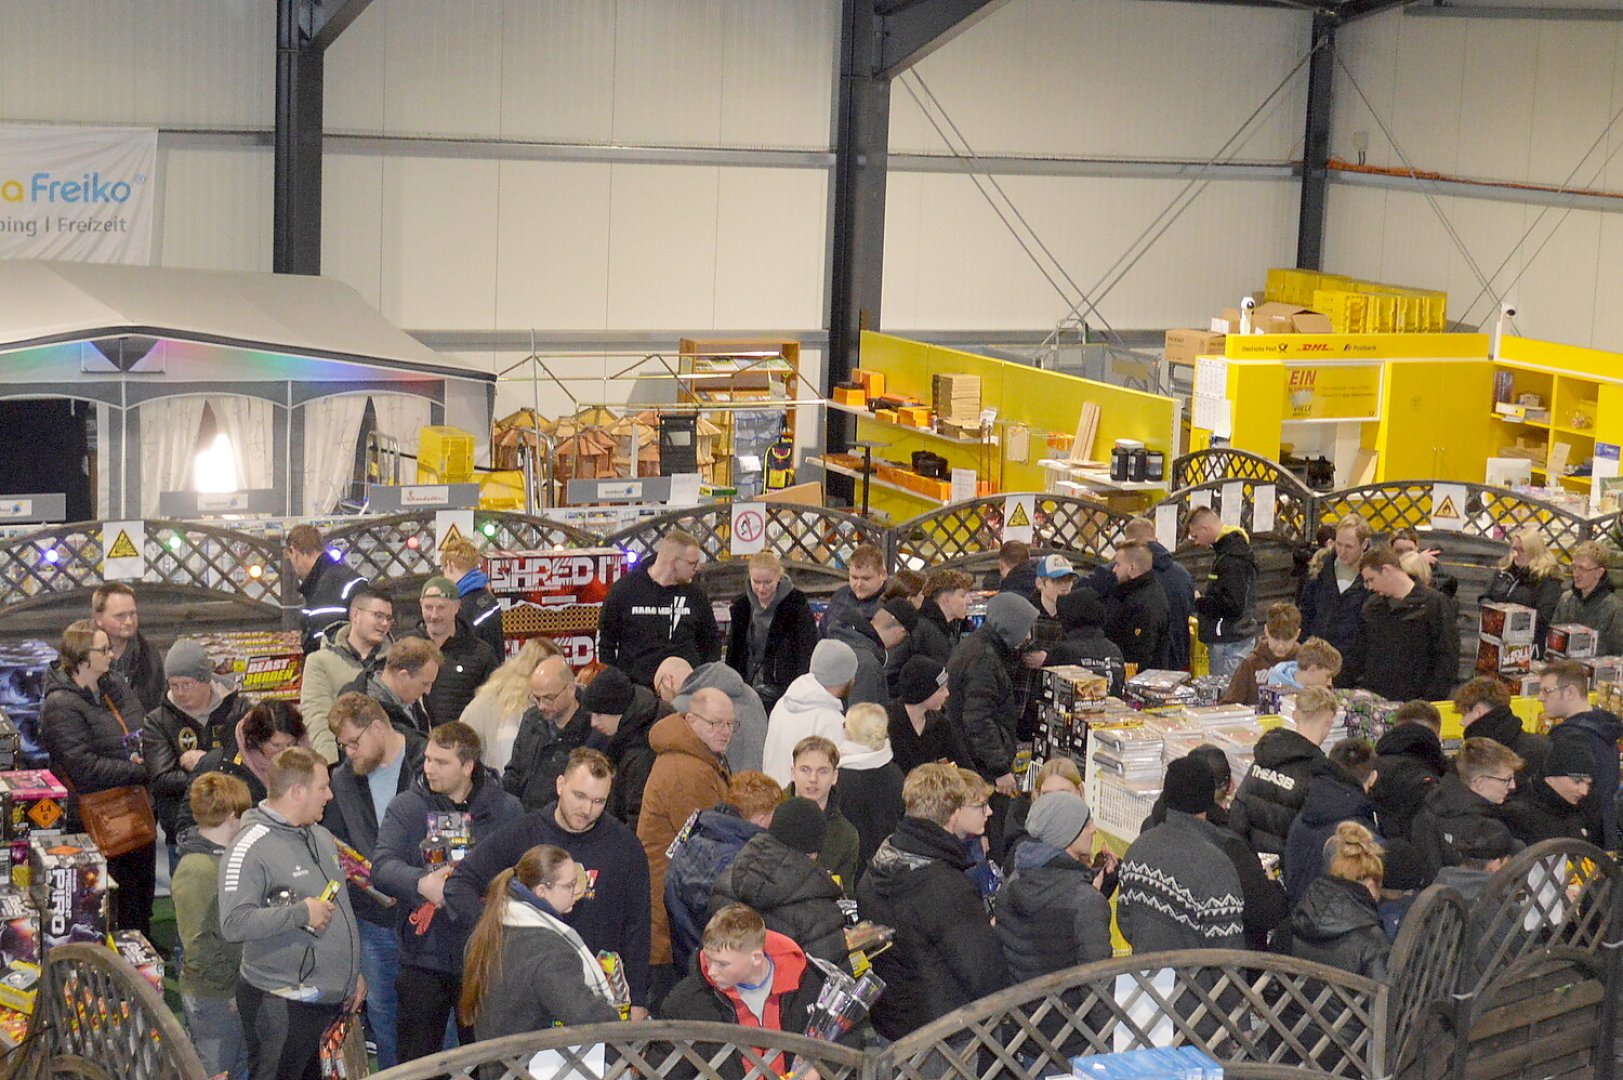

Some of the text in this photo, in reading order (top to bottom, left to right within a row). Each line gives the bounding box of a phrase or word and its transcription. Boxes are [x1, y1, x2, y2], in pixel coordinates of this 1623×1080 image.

[57, 215, 127, 233] Freizeit
[1302, 343, 1329, 351] DHL
[1289, 369, 1318, 385] EIN
[490, 556, 595, 588] SHRED
[247, 658, 290, 674] BEAST
[52, 868, 66, 935] PIRO
